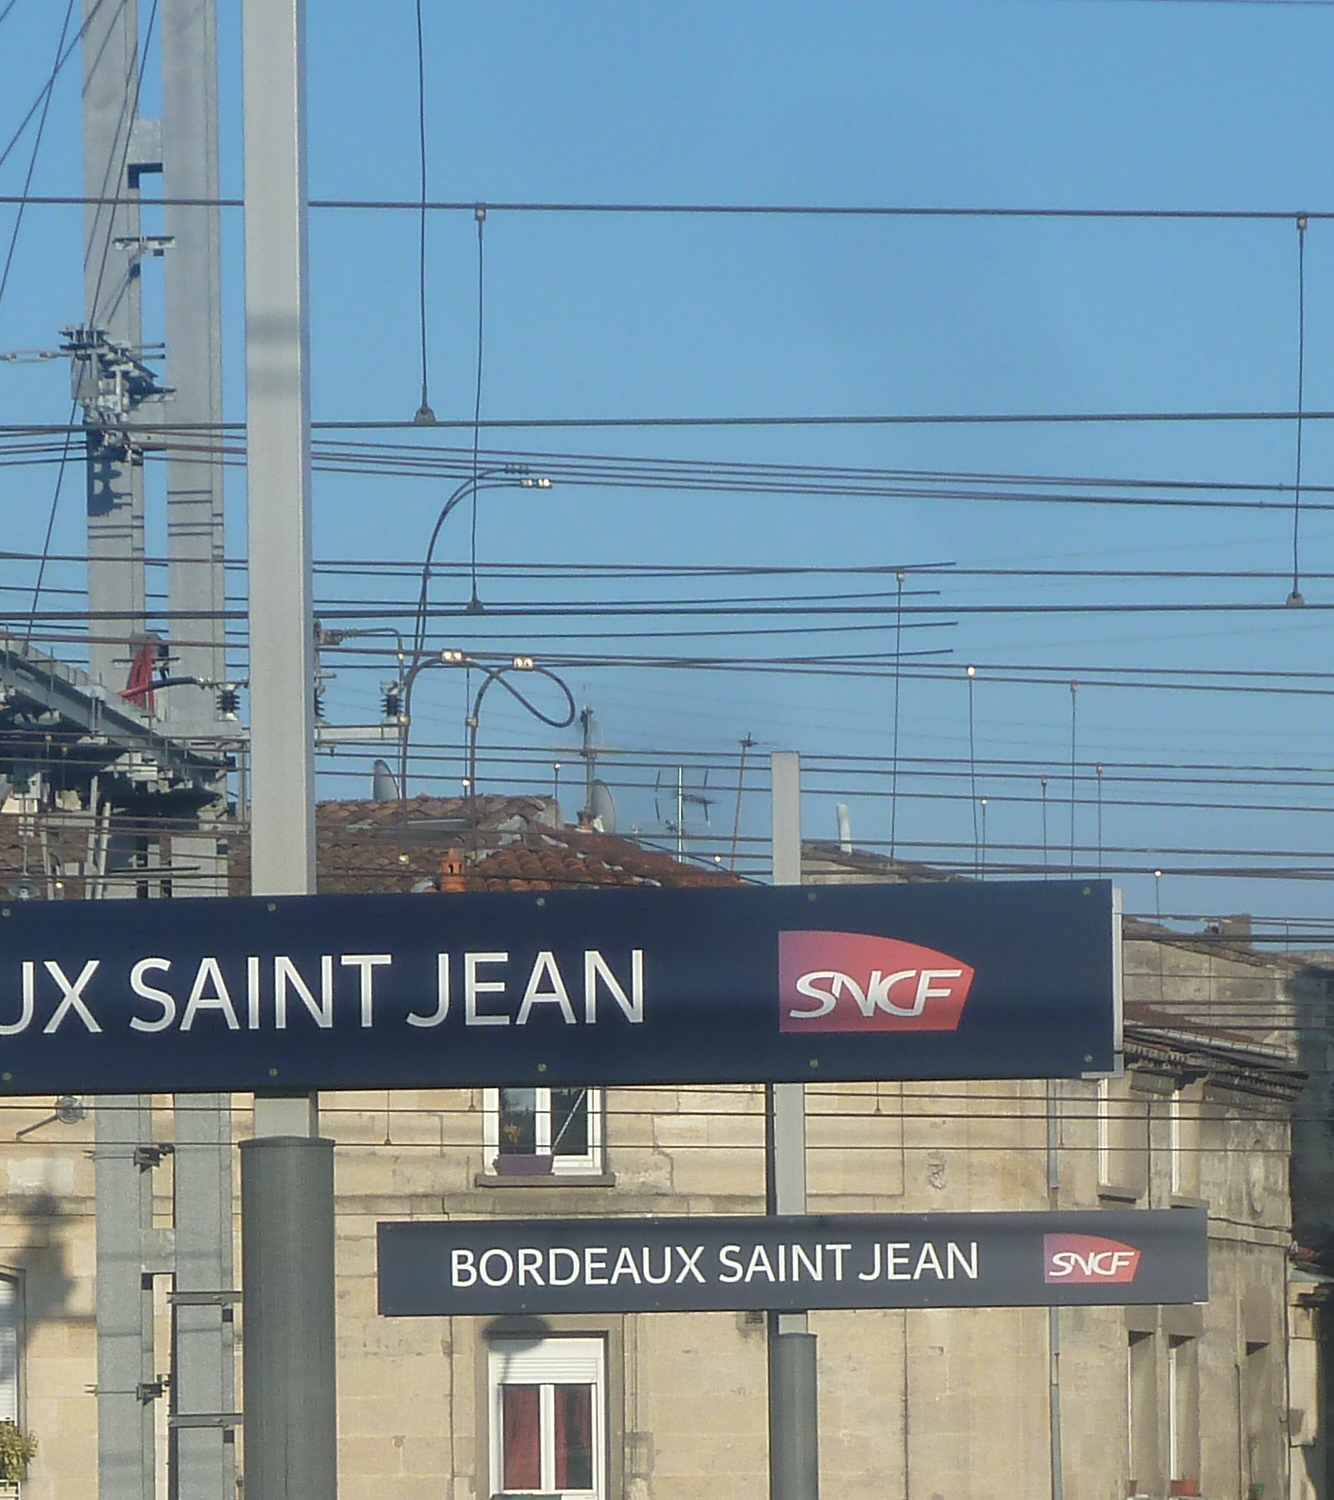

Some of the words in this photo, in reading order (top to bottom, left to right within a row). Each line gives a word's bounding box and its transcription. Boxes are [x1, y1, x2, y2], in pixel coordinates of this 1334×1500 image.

[129, 952, 392, 1033] SAINT
[406, 949, 644, 1028] JEAN
[788, 968, 964, 1019] SNCF
[451, 1246, 707, 1288] BORDEAUX
[718, 1243, 853, 1283] SAINT
[857, 1241, 979, 1281] JEAN
[1048, 1251, 1134, 1277] SNCF
